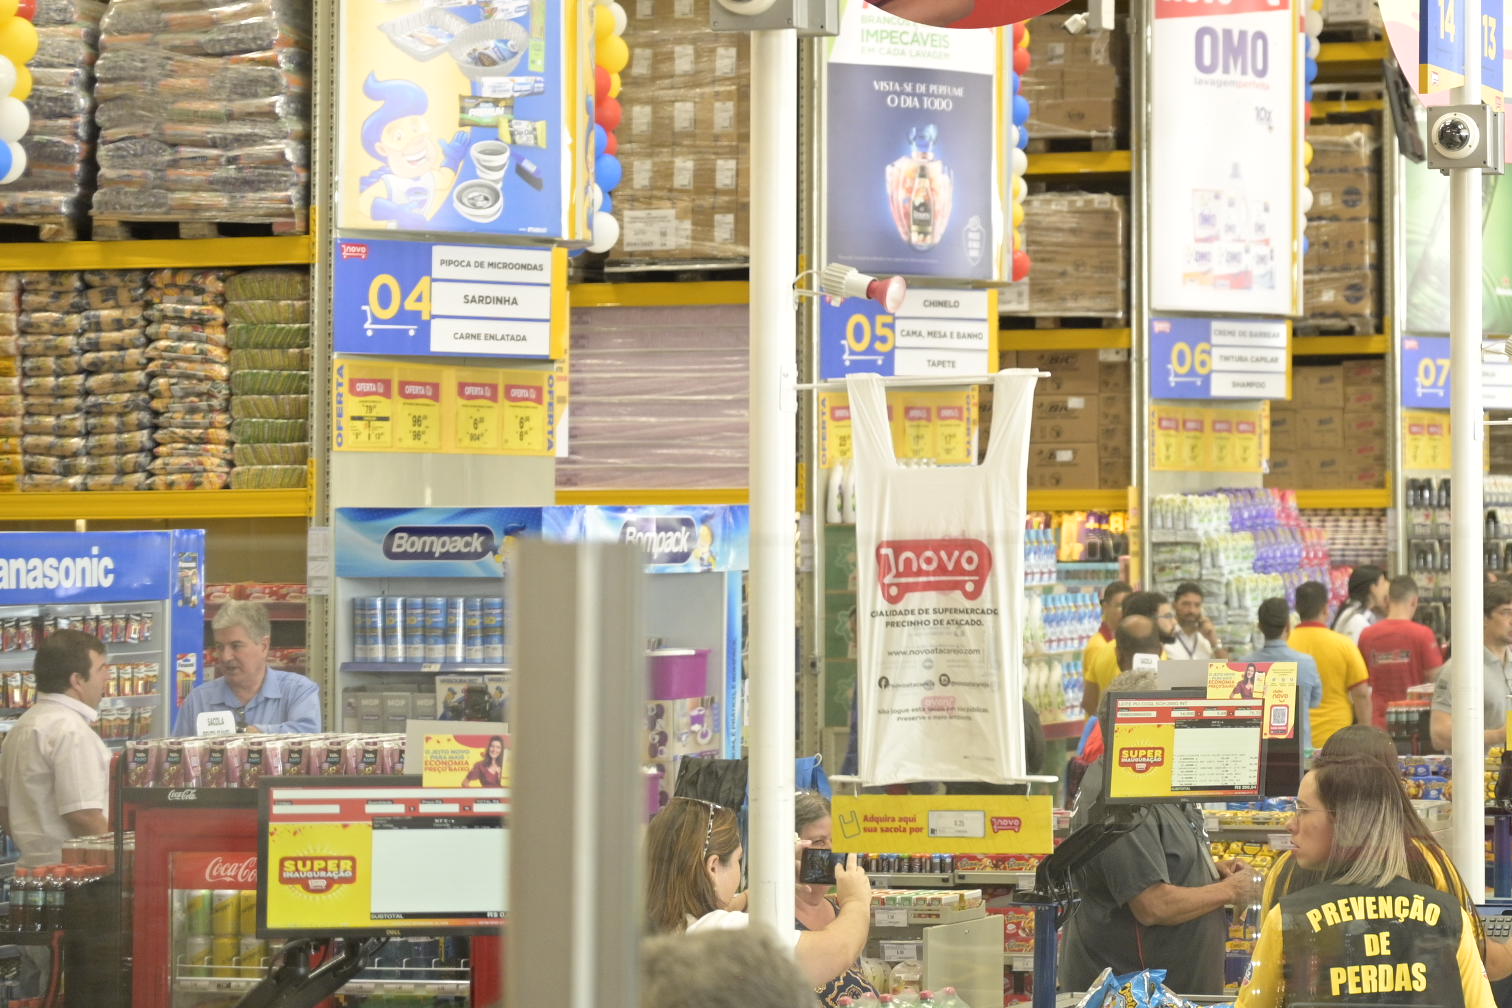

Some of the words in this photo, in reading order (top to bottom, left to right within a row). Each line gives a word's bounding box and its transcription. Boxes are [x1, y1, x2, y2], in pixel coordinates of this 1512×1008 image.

[861, 27, 950, 50] IMPECÁVEIS
[1482, 14, 1498, 61] 13
[879, 49, 906, 58] CADA
[1194, 26, 1270, 79] OMO
[873, 79, 913, 93] VISTA-SE
[915, 83, 927, 95] DE
[929, 85, 966, 97] PERFUME
[886, 94, 899, 108] O
[900, 95, 920, 109] DIA
[923, 96, 953, 112] TODO
[439, 258, 472, 269] PIPOCA
[474, 260, 486, 270] DE
[487, 261, 544, 272] MICROONDAS
[368, 273, 432, 321] 04
[463, 294, 519, 307] SARDINHA
[923, 299, 960, 309] CHINELO
[453, 332, 482, 342] CARNE
[484, 333, 527, 343] ENLATADA
[846, 313, 896, 353] 05
[900, 328, 925, 340] CAMA,
[927, 330, 948, 340] MESA
[949, 331, 955, 340] E
[956, 331, 984, 342] BANHO
[926, 359, 957, 370] TAPETE
[1170, 341, 1213, 376] 06
[356, 382, 377, 393] OFERTA
[405, 384, 427, 395] OFERTA
[464, 386, 486, 396] OFERTA
[510, 388, 531, 398] OFERTA
[335, 365, 346, 448] OFERTA
[547, 374, 555, 451] OFERTA
[391, 532, 485, 558] Bompack
[898, 549, 980, 573] novo
[0, 546, 115, 590] anasonic
[917, 608, 930, 616] DE
[885, 619, 931, 628] PRECINHO
[933, 618, 945, 626] DE
[1120, 756, 1163, 764] INAUGURAÇÃO
[1121, 749, 1163, 759] SUPER
[424, 766, 447, 774] PREÇO
[862, 812, 896, 825] Adquira
[897, 813, 917, 825] aqui
[862, 825, 879, 834] sua
[880, 824, 907, 834] sacola
[909, 824, 925, 836] por
[282, 859, 353, 872] SUPER
[282, 870, 353, 880] INAUGURAÇÃO
[1305, 894, 1442, 933] PREVENÇÃO
[1363, 931, 1392, 957] DE
[1329, 962, 1428, 996] PERDAS
